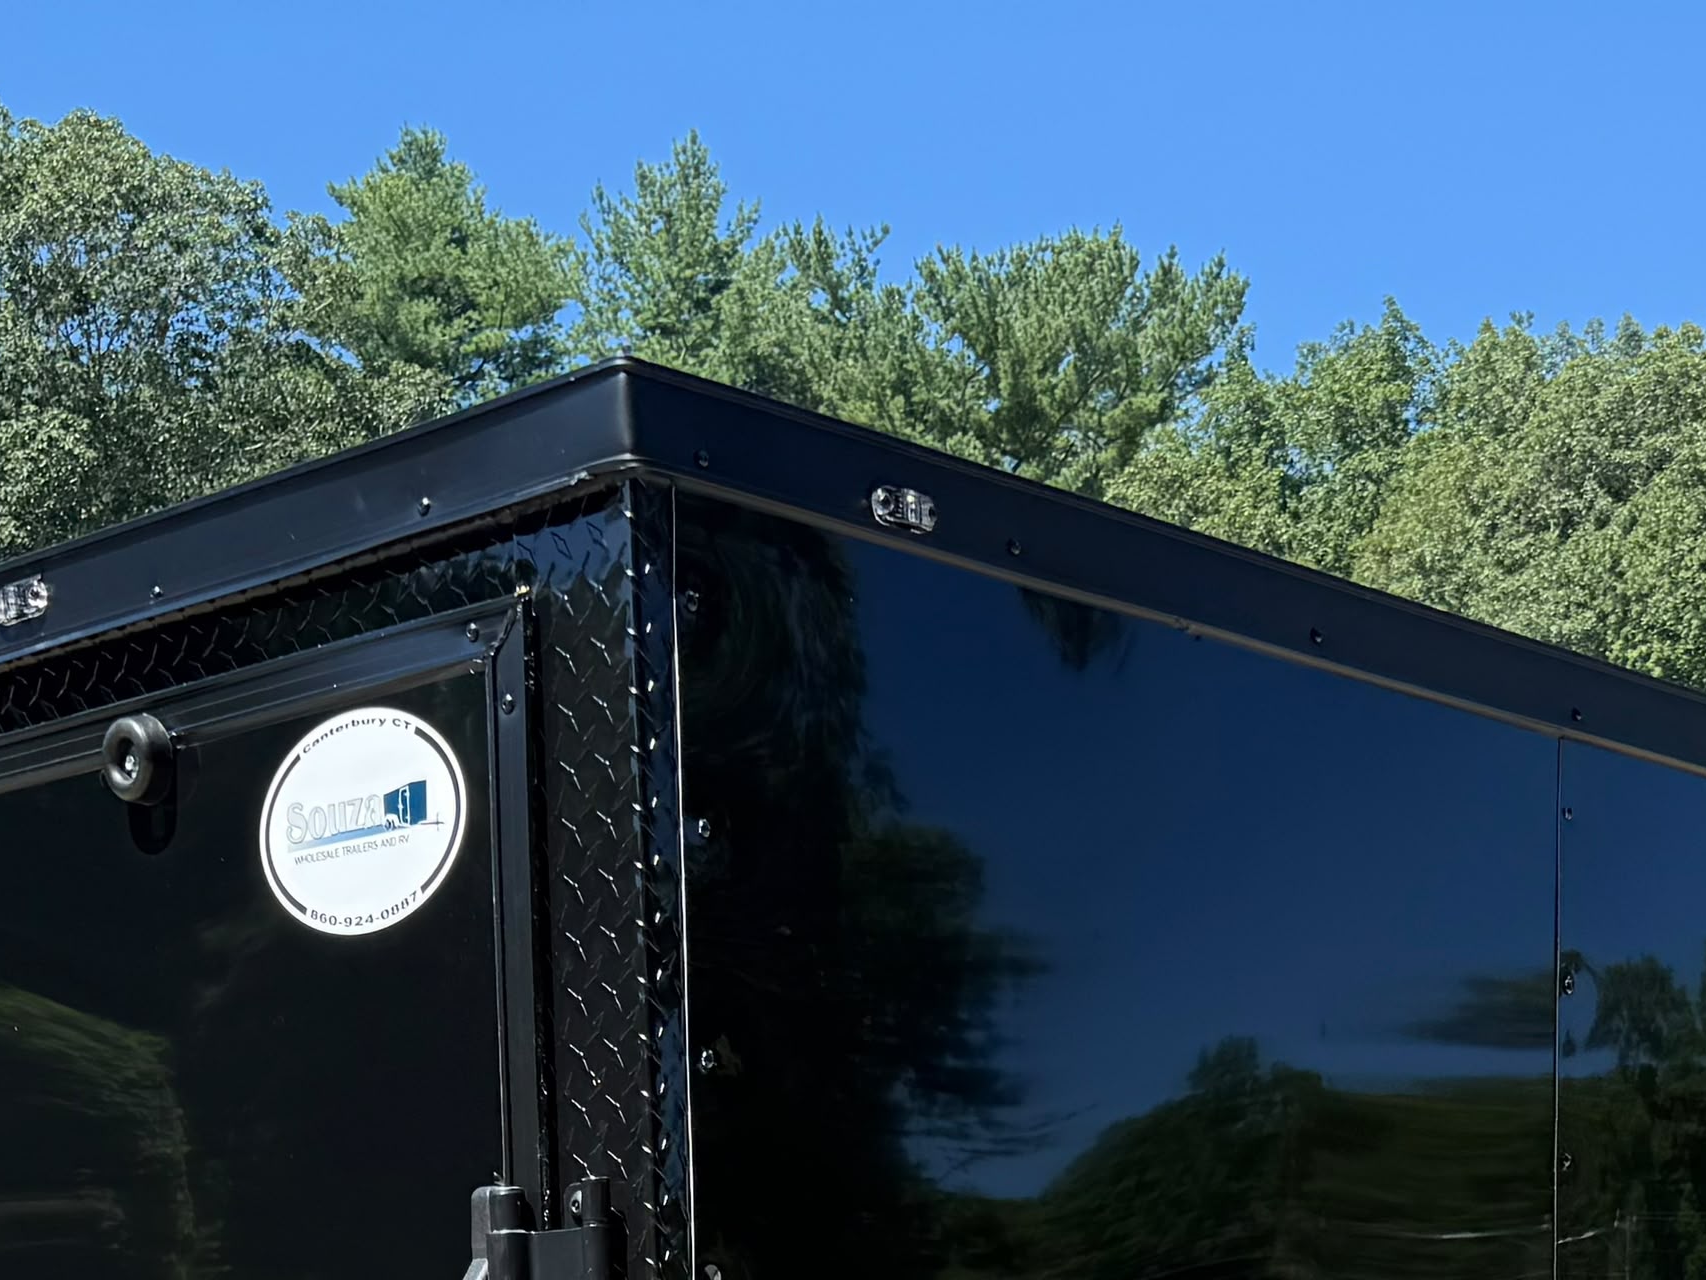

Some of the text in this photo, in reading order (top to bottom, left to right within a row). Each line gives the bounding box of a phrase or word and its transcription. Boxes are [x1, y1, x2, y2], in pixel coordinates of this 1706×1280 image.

[302, 717, 413, 754] Canterbury CT
[285, 793, 384, 844] Souza
[294, 848, 340, 865] WHOLESALE
[341, 840, 378, 857] TRAILERS
[380, 837, 397, 849] AND
[310, 889, 419, 927] 860-924-0887
